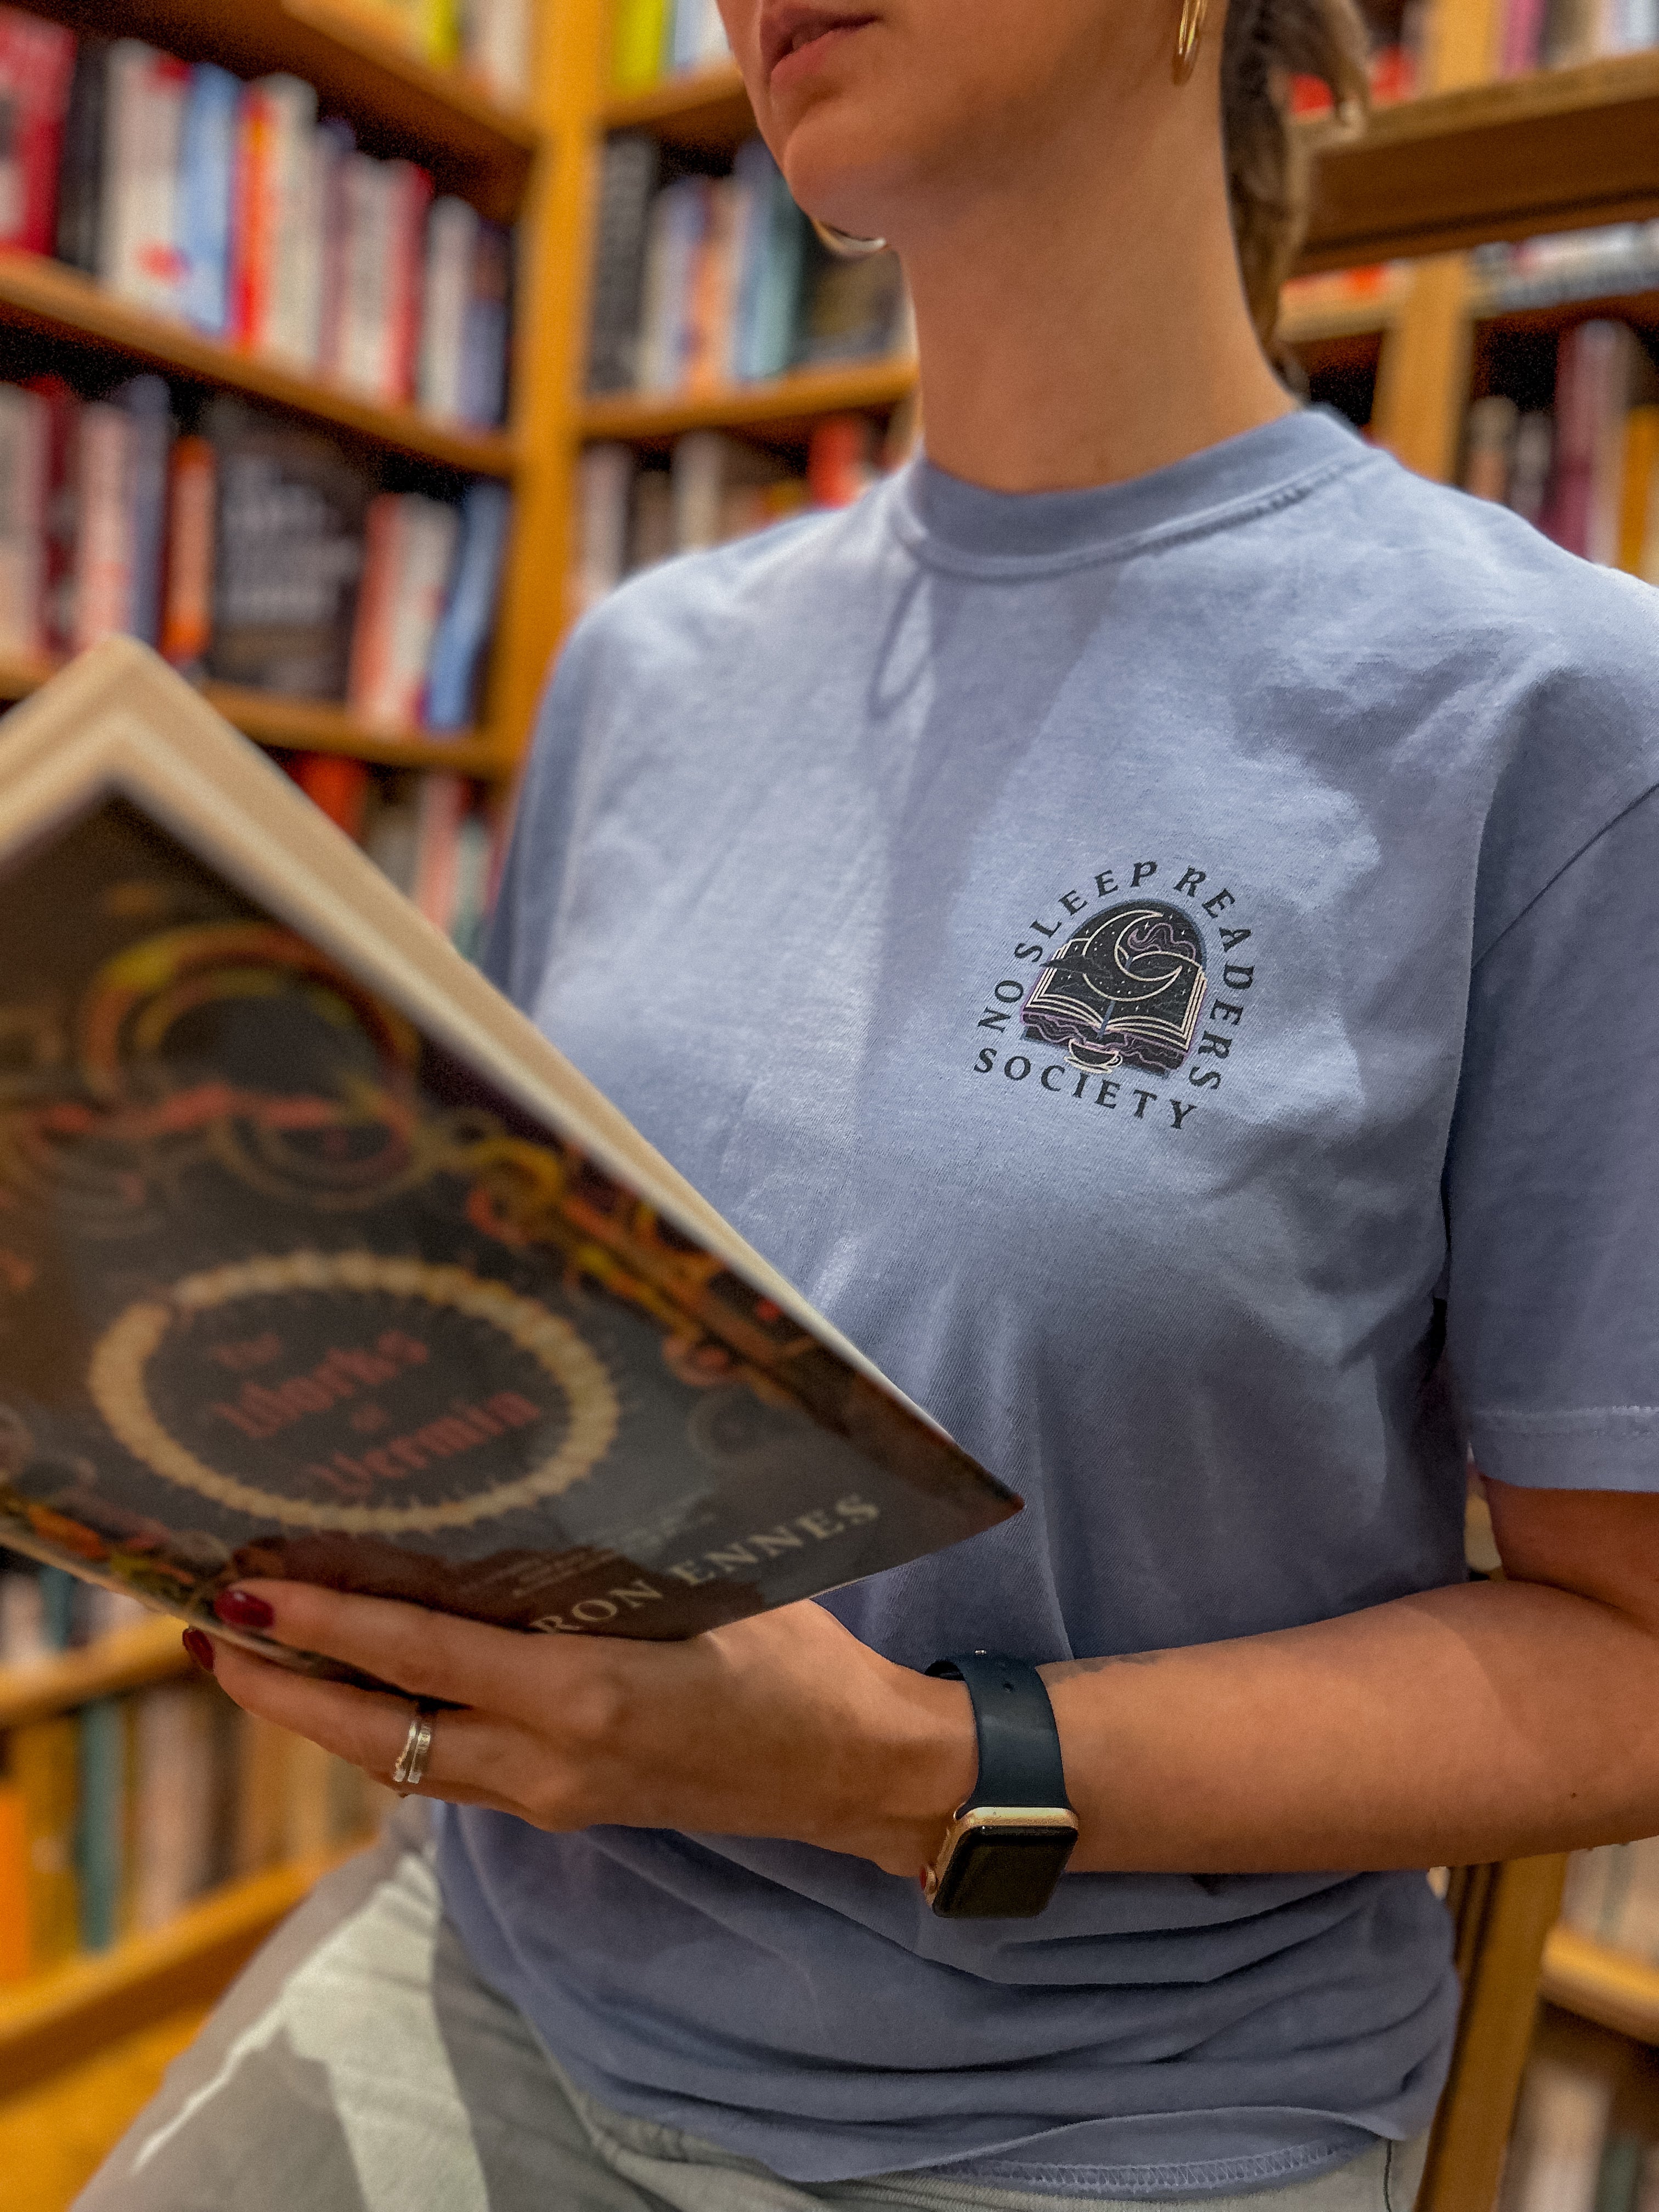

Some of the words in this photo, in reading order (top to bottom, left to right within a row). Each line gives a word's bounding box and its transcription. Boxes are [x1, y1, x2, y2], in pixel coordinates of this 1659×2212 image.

[978, 979, 1024, 1034] NO
[1014, 861, 1158, 963] SLEEP
[1174, 866, 1254, 1090] READERS
[974, 1047, 1197, 1130] SOCIETY
[669, 1492, 879, 1587] ENNES
